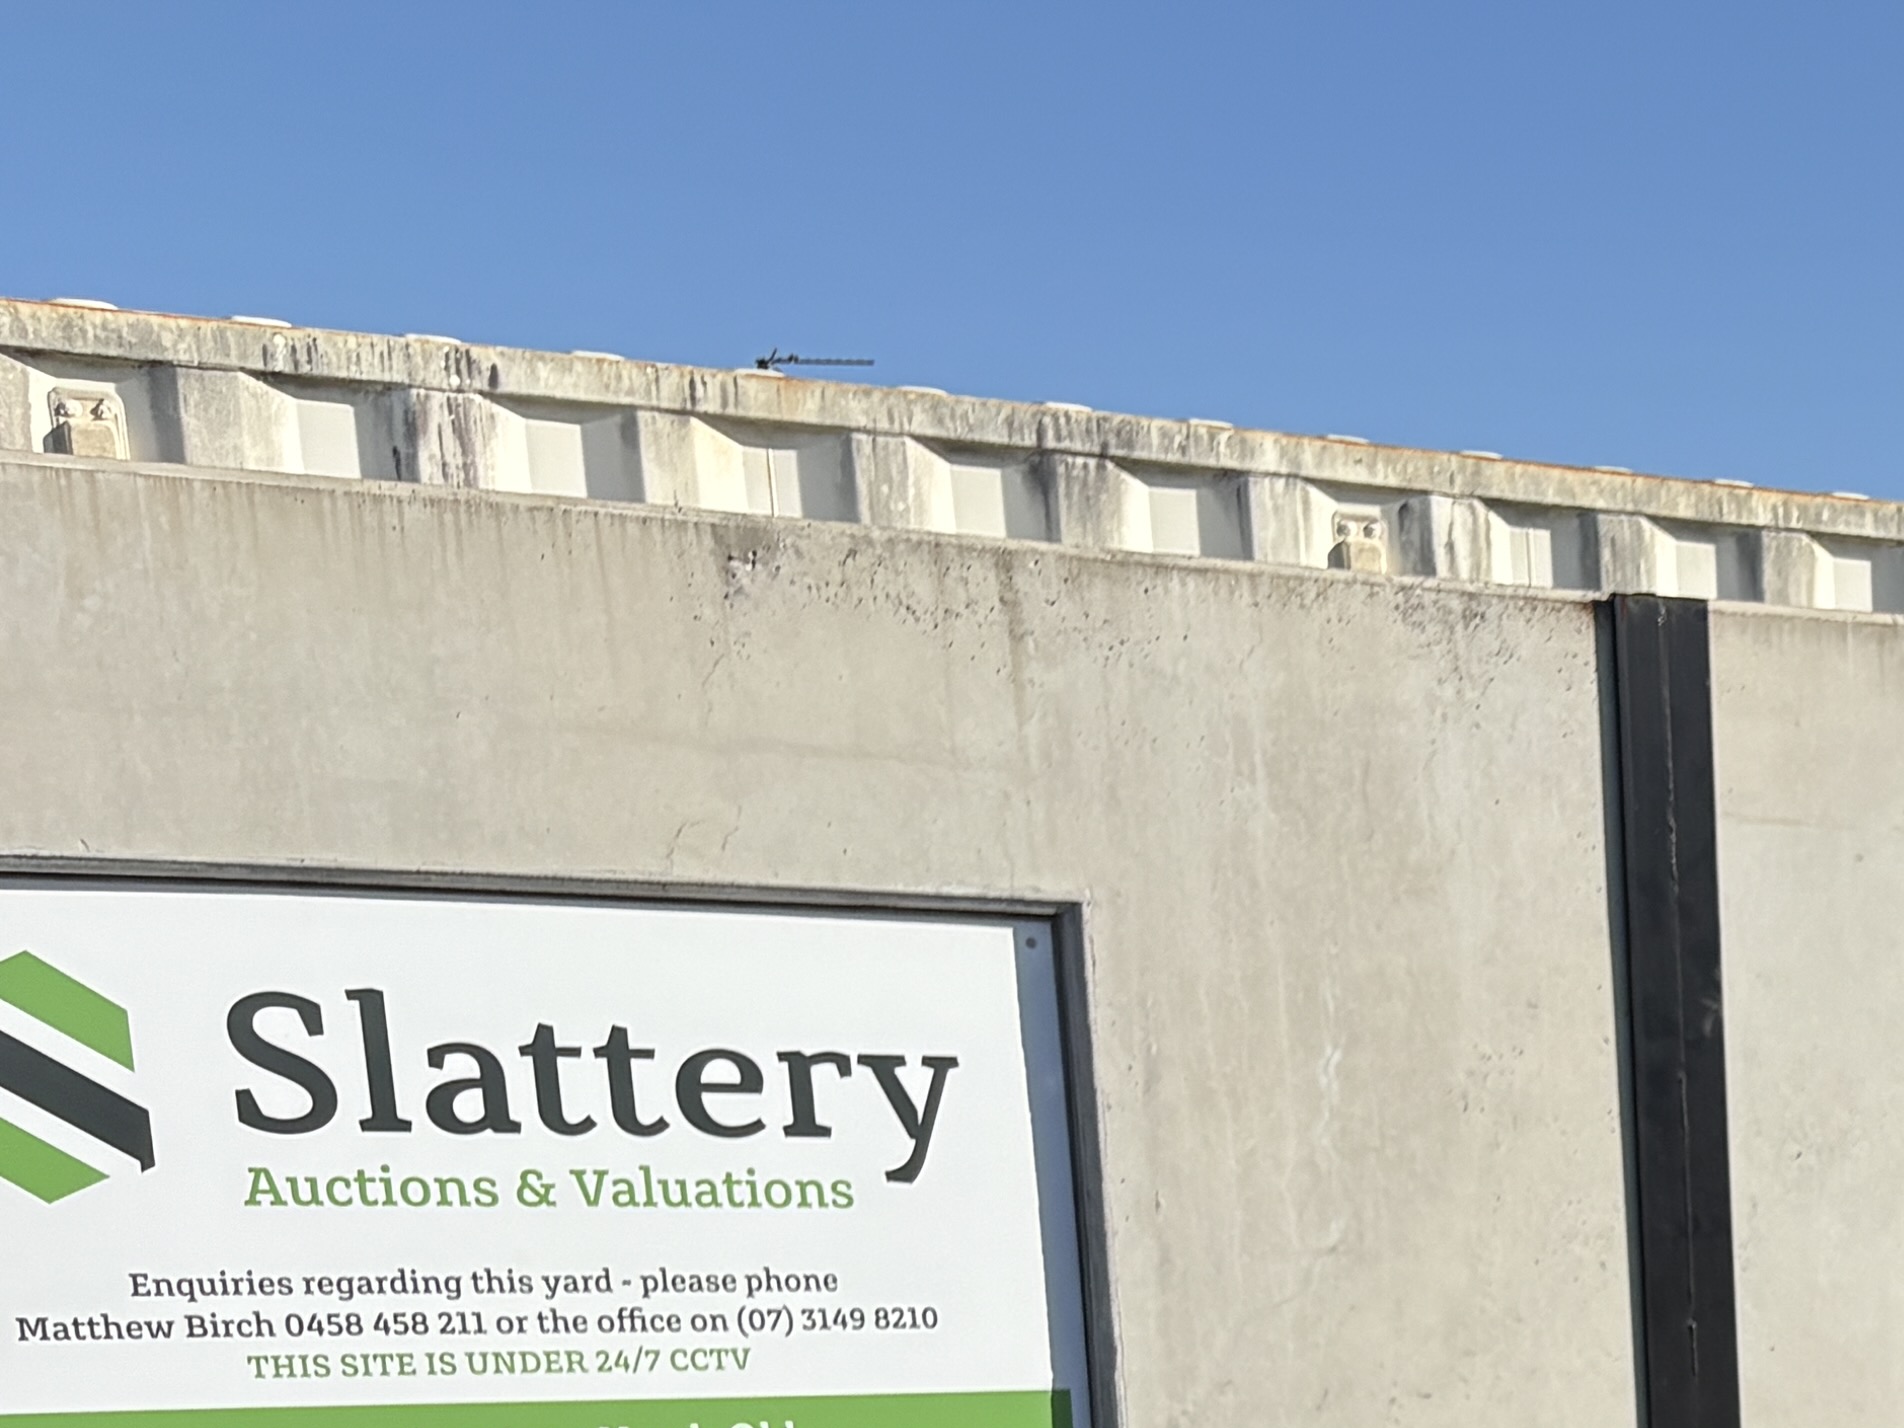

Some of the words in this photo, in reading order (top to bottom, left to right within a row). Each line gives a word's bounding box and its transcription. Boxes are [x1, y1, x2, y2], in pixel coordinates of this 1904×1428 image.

[226, 988, 960, 1185] Slattery
[243, 1164, 499, 1210] Auctions
[516, 1167, 557, 1210] &
[571, 1165, 856, 1212] Valuations
[128, 1269, 295, 1304] Enquiries
[302, 1268, 463, 1302] regarding
[471, 1268, 535, 1296] this
[541, 1267, 614, 1302] yard
[640, 1267, 738, 1301] please
[745, 1266, 840, 1300] phone
[15, 1313, 175, 1342] Matthew
[184, 1310, 277, 1339] Birch
[285, 1313, 366, 1339] 0458
[373, 1312, 431, 1338] 458
[438, 1311, 489, 1337] 211
[496, 1316, 530, 1336] or
[537, 1308, 590, 1335] the
[597, 1307, 683, 1335] office
[690, 1314, 730, 1334] on
[737, 1305, 796, 1339] (07)
[801, 1308, 867, 1332] 3149
[874, 1307, 940, 1331] 8210
[247, 1355, 332, 1380] THIS
[341, 1354, 418, 1378] SITE
[426, 1353, 458, 1377] IS
[466, 1351, 588, 1376] UNDER
[596, 1347, 661, 1376] 24/7
[671, 1349, 751, 1372] CCTV
